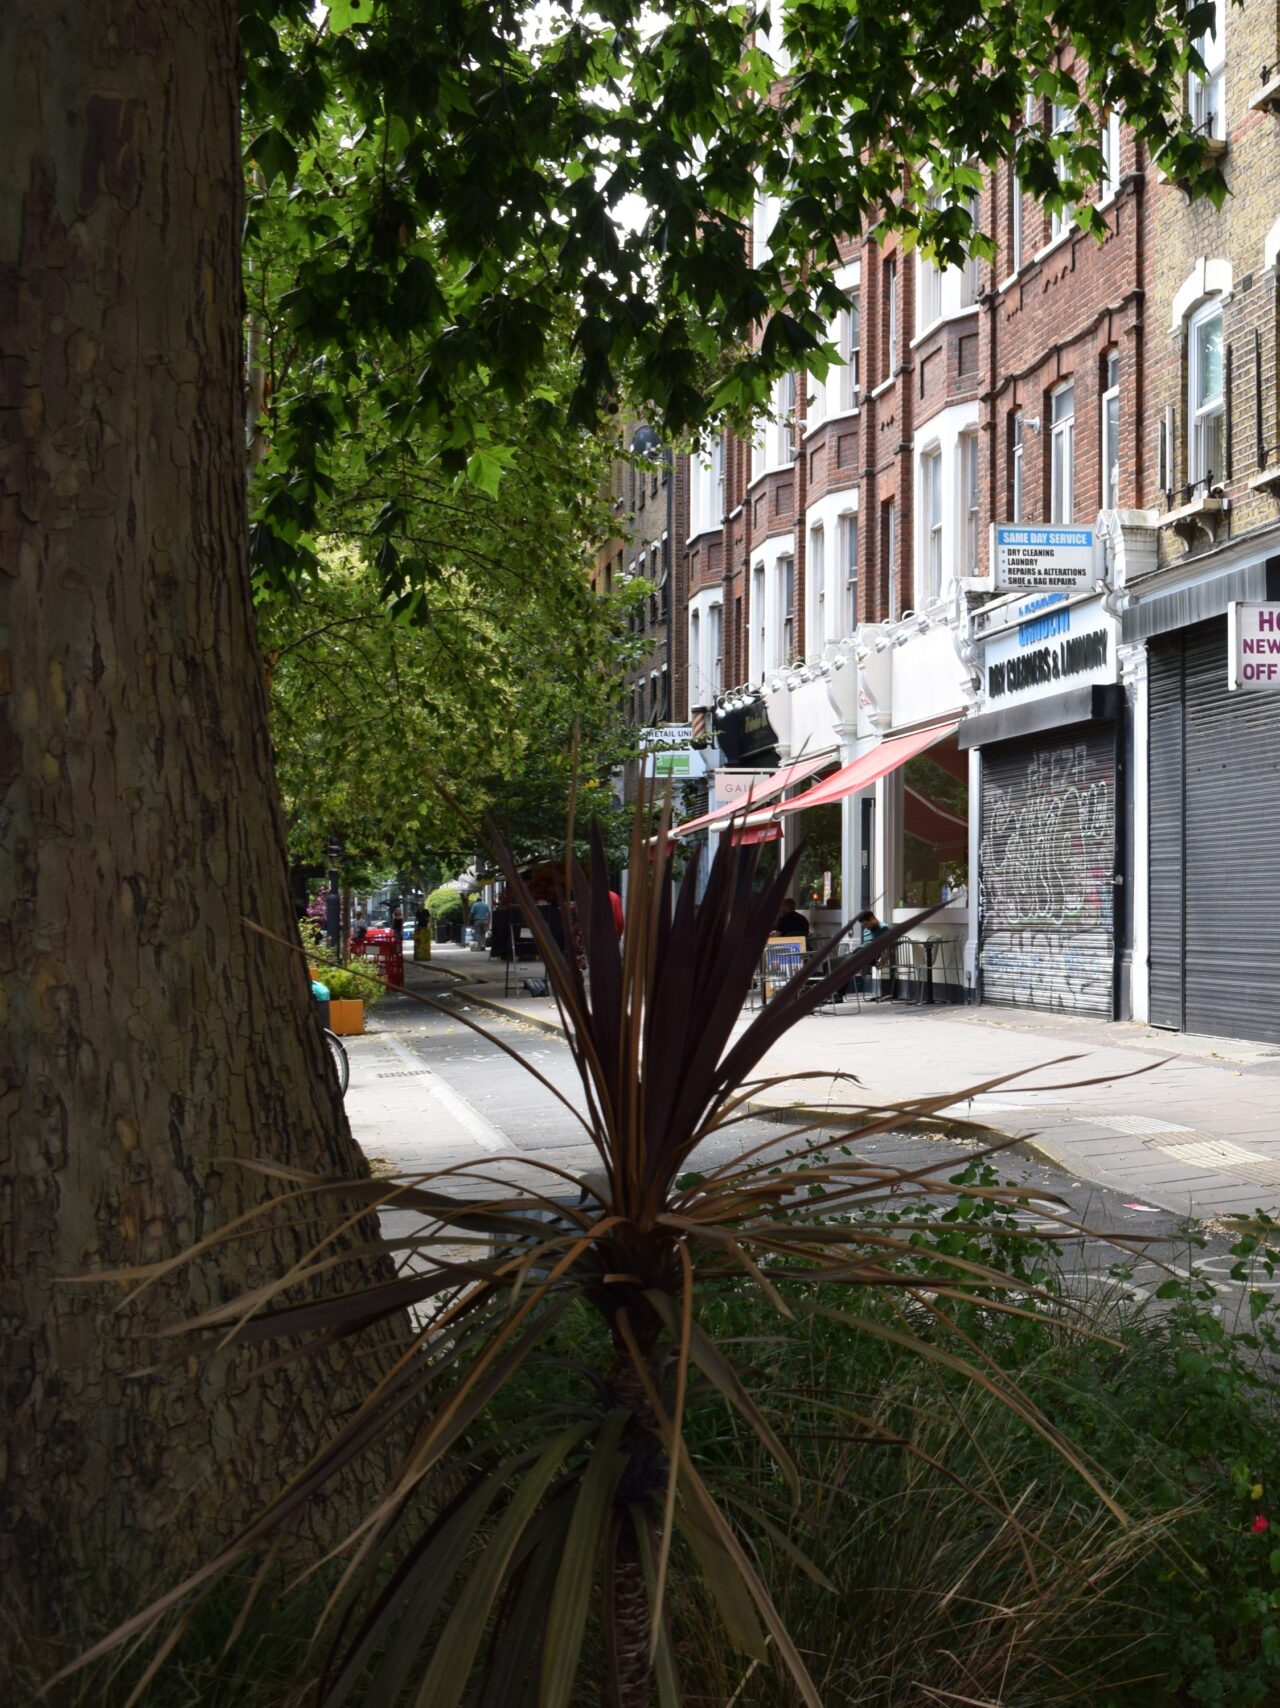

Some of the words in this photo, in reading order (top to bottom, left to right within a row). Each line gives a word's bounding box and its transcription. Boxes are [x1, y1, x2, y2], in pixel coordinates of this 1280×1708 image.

[1003, 532, 1029, 544] SAME
[1030, 532, 1048, 544] DAY
[1049, 533, 1087, 545] SERVICE
[1007, 548, 1021, 557] DRY
[1022, 549, 1055, 557] CLEANING
[1007, 558, 1038, 566] LAUNDRY
[1007, 567, 1036, 576] REPAIRS
[1043, 568, 1087, 577] ALTERATIONS
[1008, 576, 1026, 585] SHOE
[1033, 577, 1048, 586] BAG
[1048, 577, 1077, 586] REPAIRS
[1052, 649, 1060, 680] &
[1060, 628, 1108, 677] LAUNDRY
[1243, 663, 1278, 681] OFF
